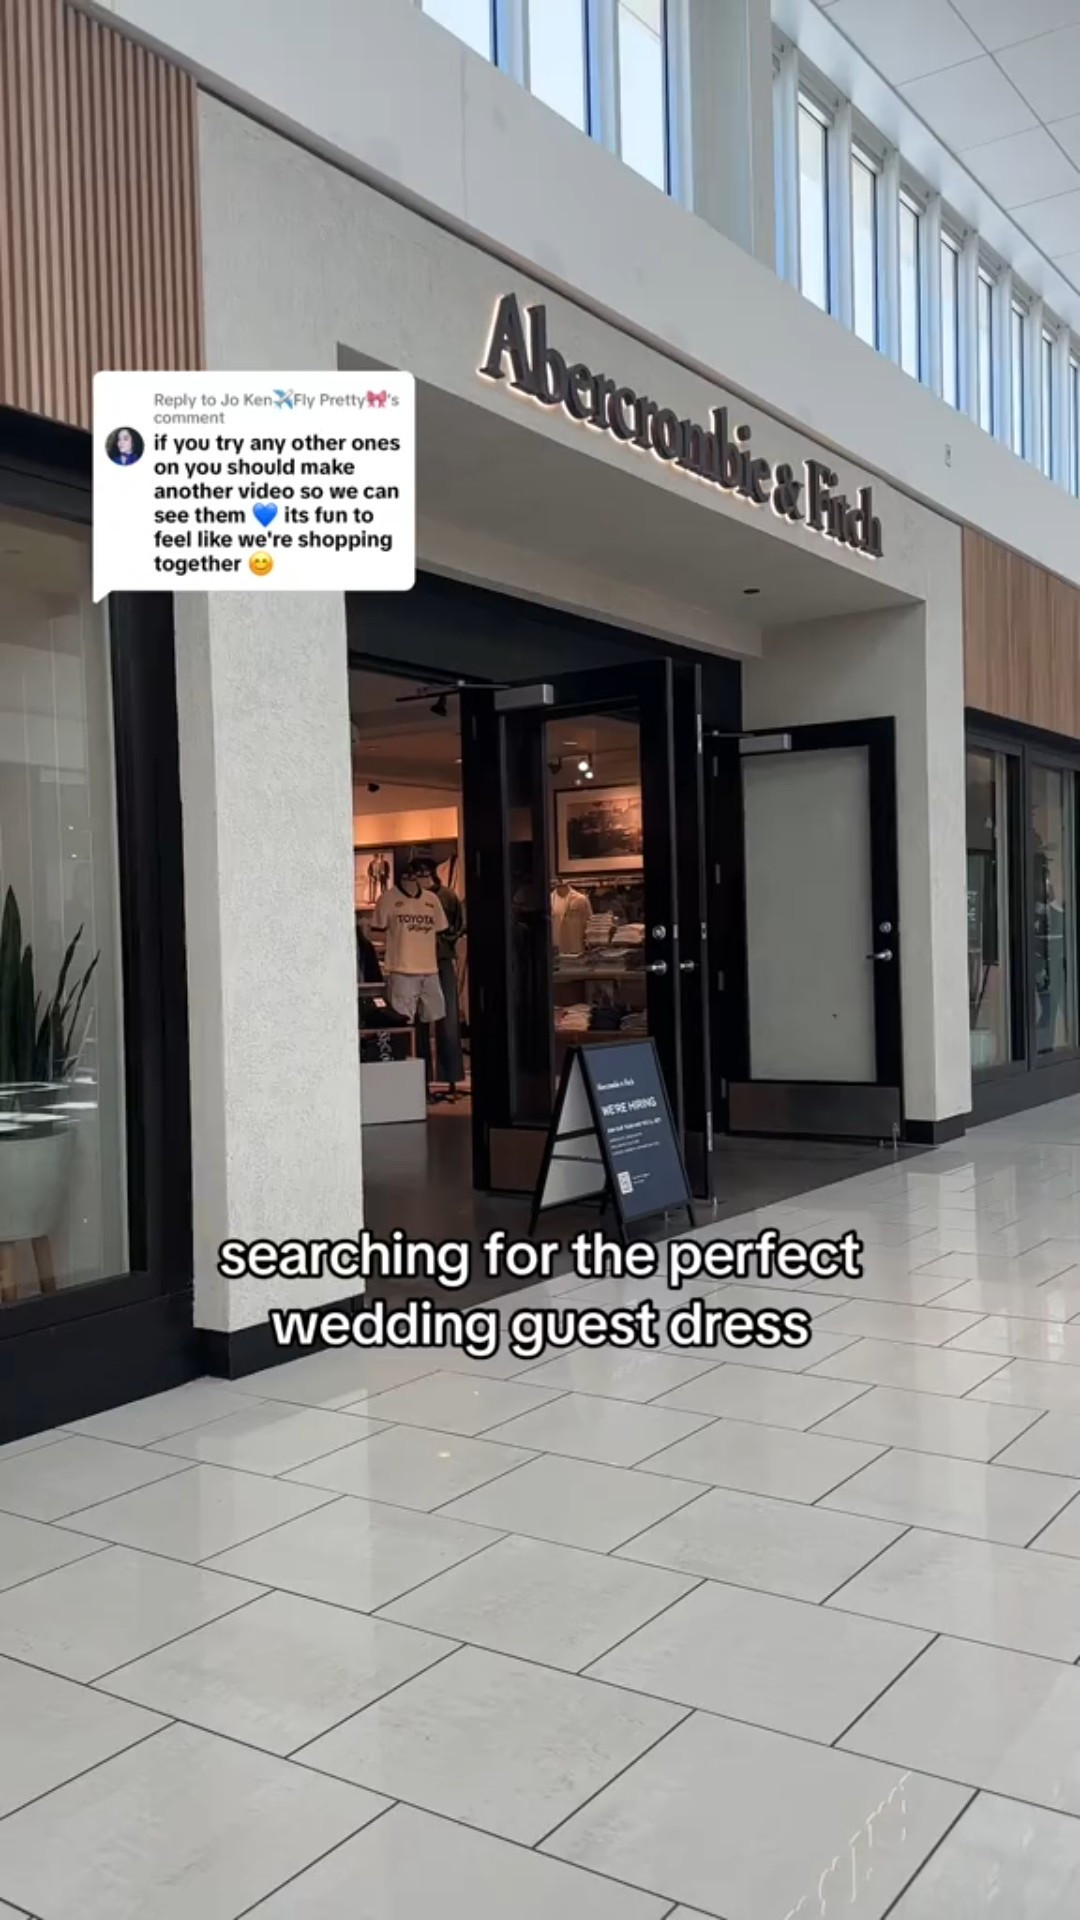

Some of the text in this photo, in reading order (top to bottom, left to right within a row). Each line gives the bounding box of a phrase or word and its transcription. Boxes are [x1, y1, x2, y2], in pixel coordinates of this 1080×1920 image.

[478, 292, 883, 558] Abercrombie & Fitch
[397, 914, 435, 925] TOYOTA
[628, 1096, 657, 1111] HIRING
